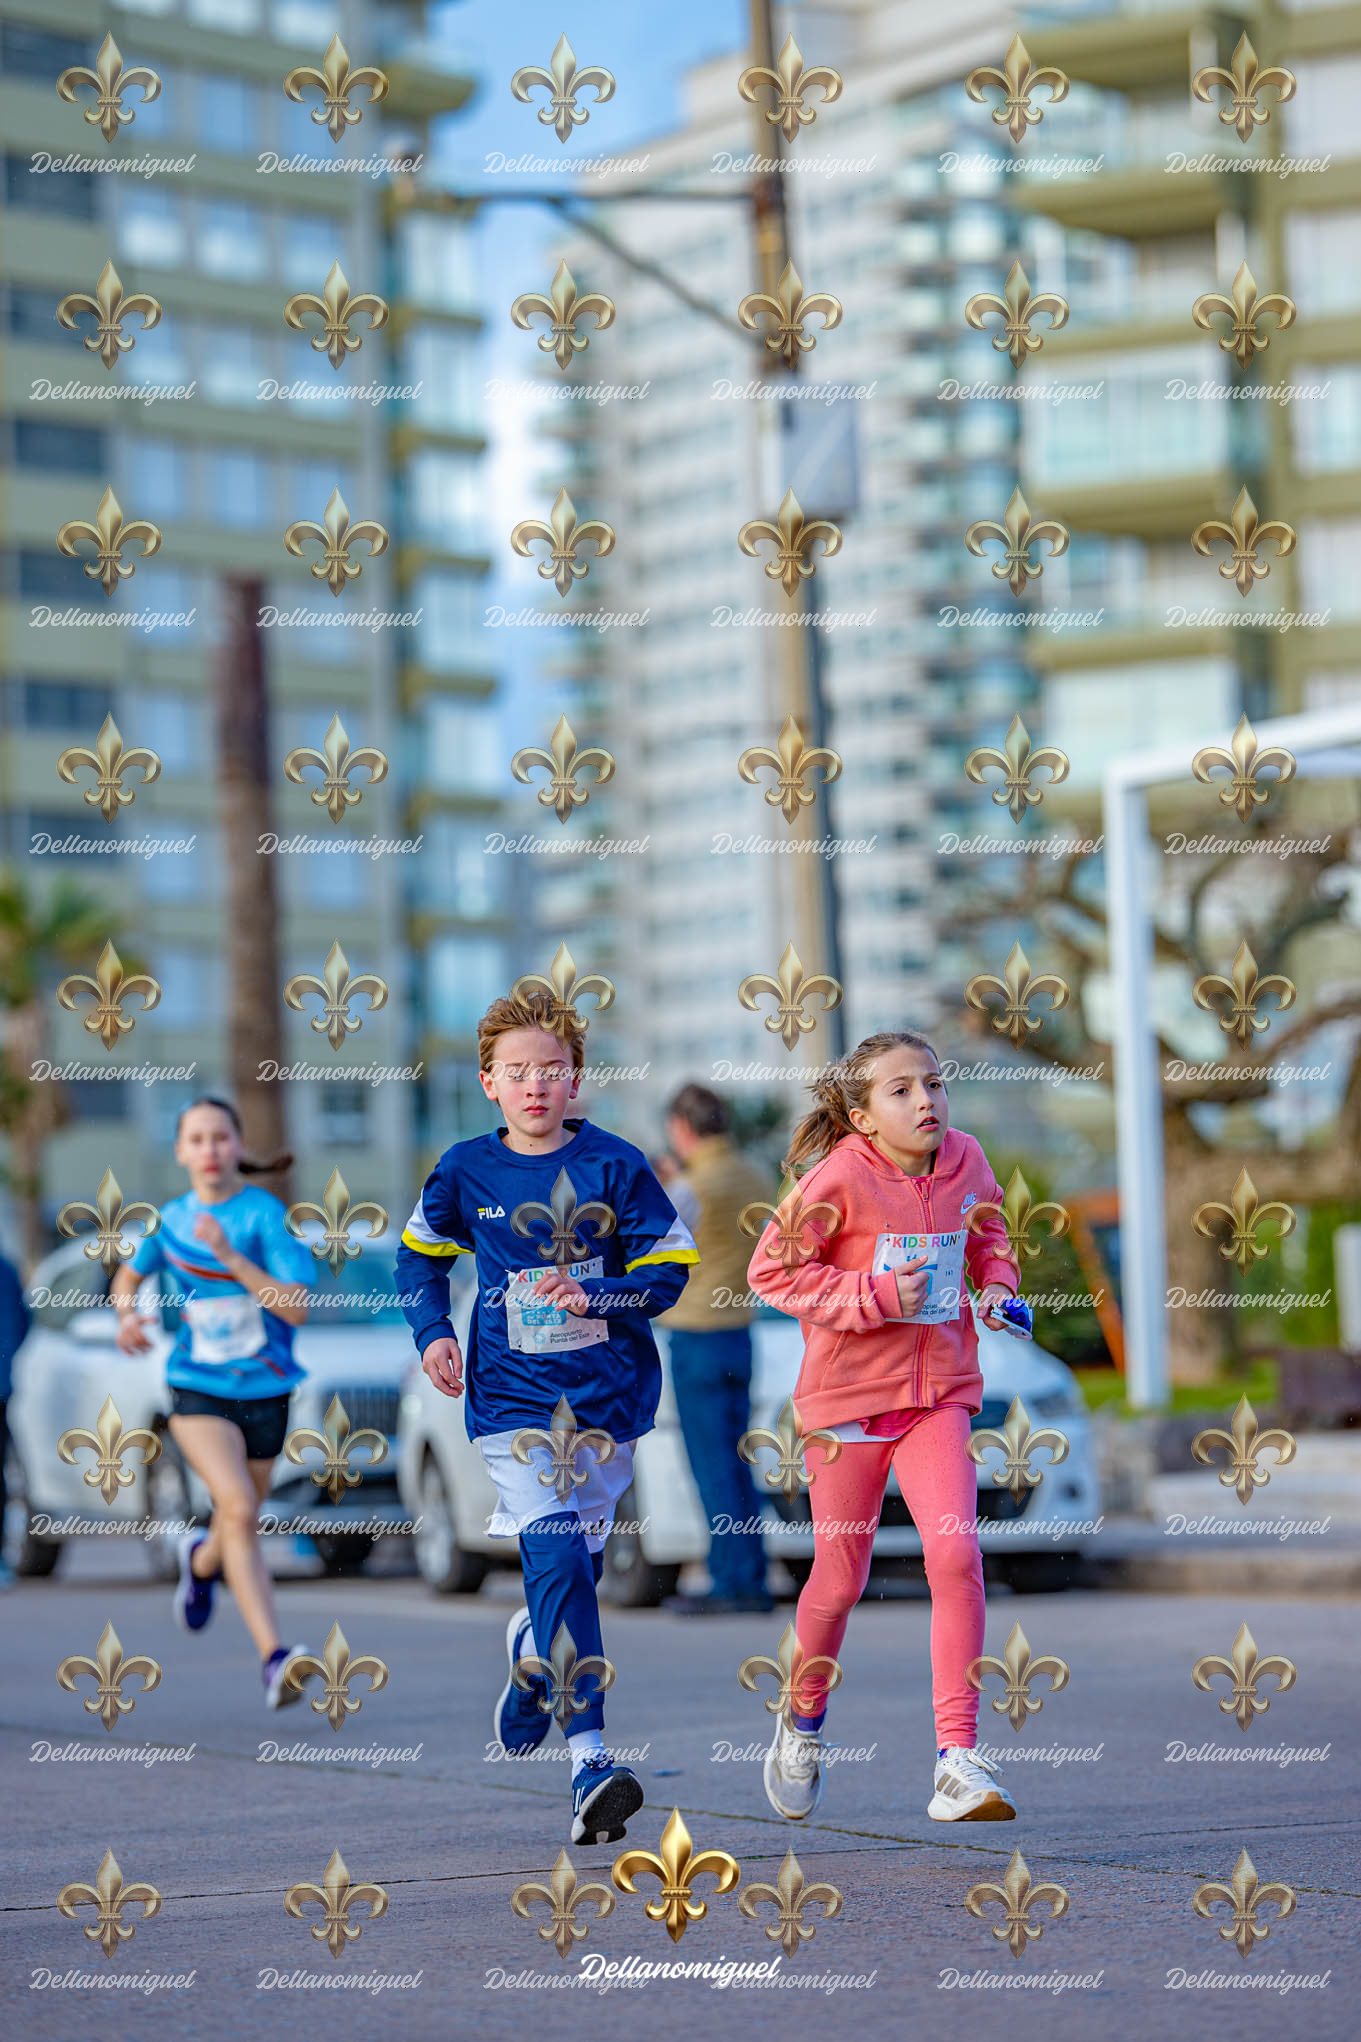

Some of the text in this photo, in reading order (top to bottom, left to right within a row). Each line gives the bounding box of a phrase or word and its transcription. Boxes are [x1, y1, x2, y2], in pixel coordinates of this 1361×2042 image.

[477, 1205, 506, 1220] FILA
[892, 1234, 957, 1248] KIDS RUN
